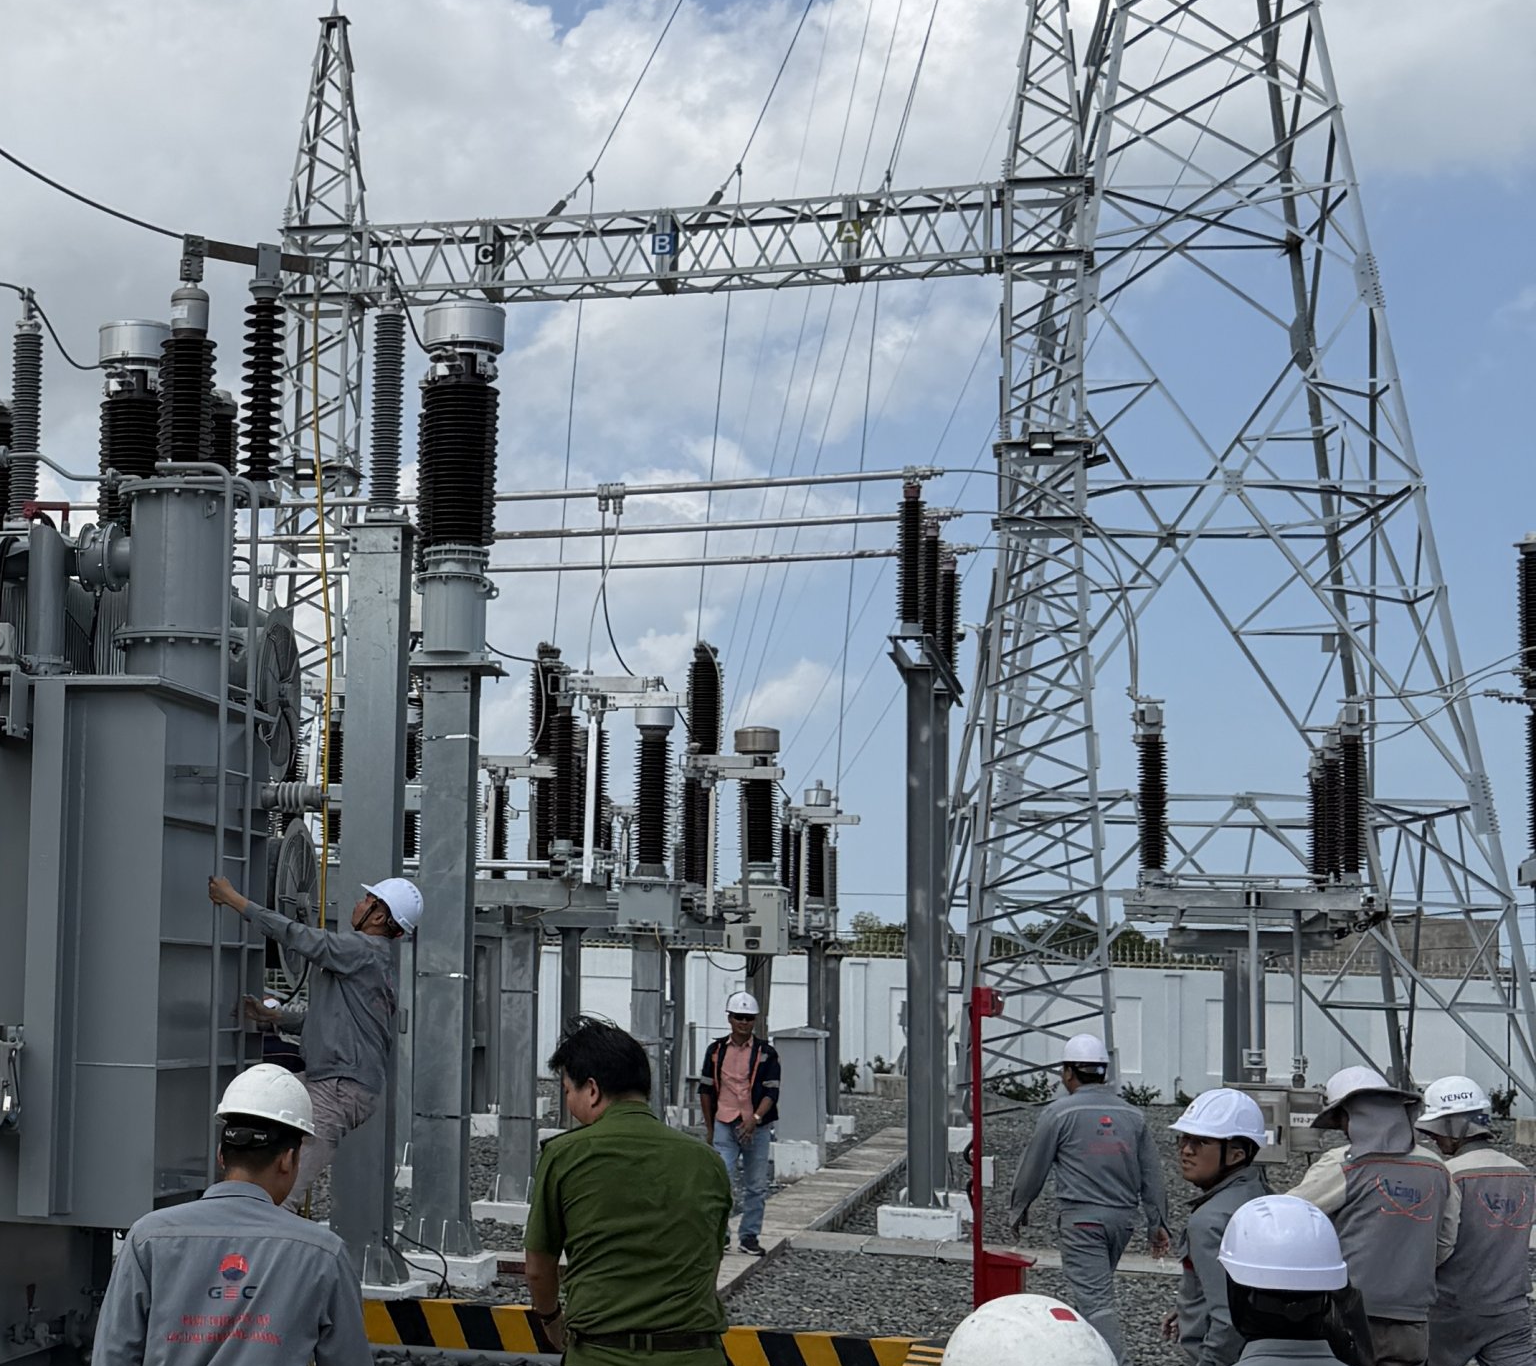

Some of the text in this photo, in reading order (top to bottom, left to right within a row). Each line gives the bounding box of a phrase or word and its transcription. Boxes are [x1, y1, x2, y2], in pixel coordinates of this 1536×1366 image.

[840, 222, 858, 241] A
[655, 235, 670, 253] B
[478, 245, 493, 263] C
[208, 1286, 258, 1300] GEC
